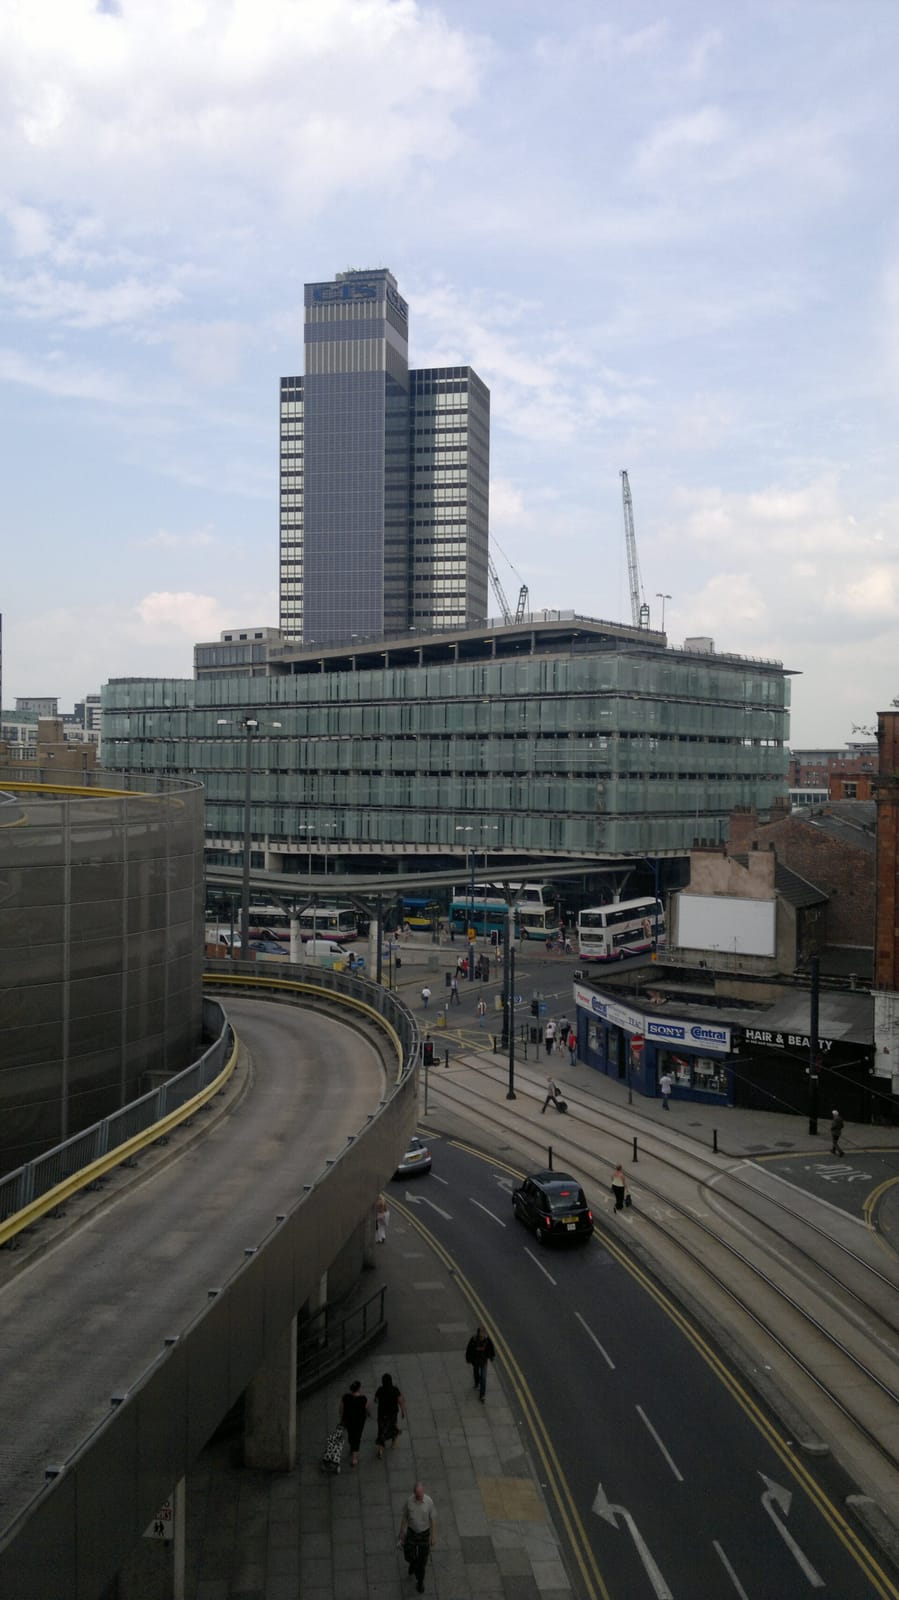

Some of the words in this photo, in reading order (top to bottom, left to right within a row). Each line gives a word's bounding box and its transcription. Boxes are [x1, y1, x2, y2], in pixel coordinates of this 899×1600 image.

[649, 1025, 683, 1037] SONY
[690, 1025, 726, 1040] Central
[745, 1029, 773, 1042] HAIR
[776, 1033, 785, 1044] &
[788, 1035, 833, 1050] BEATY
